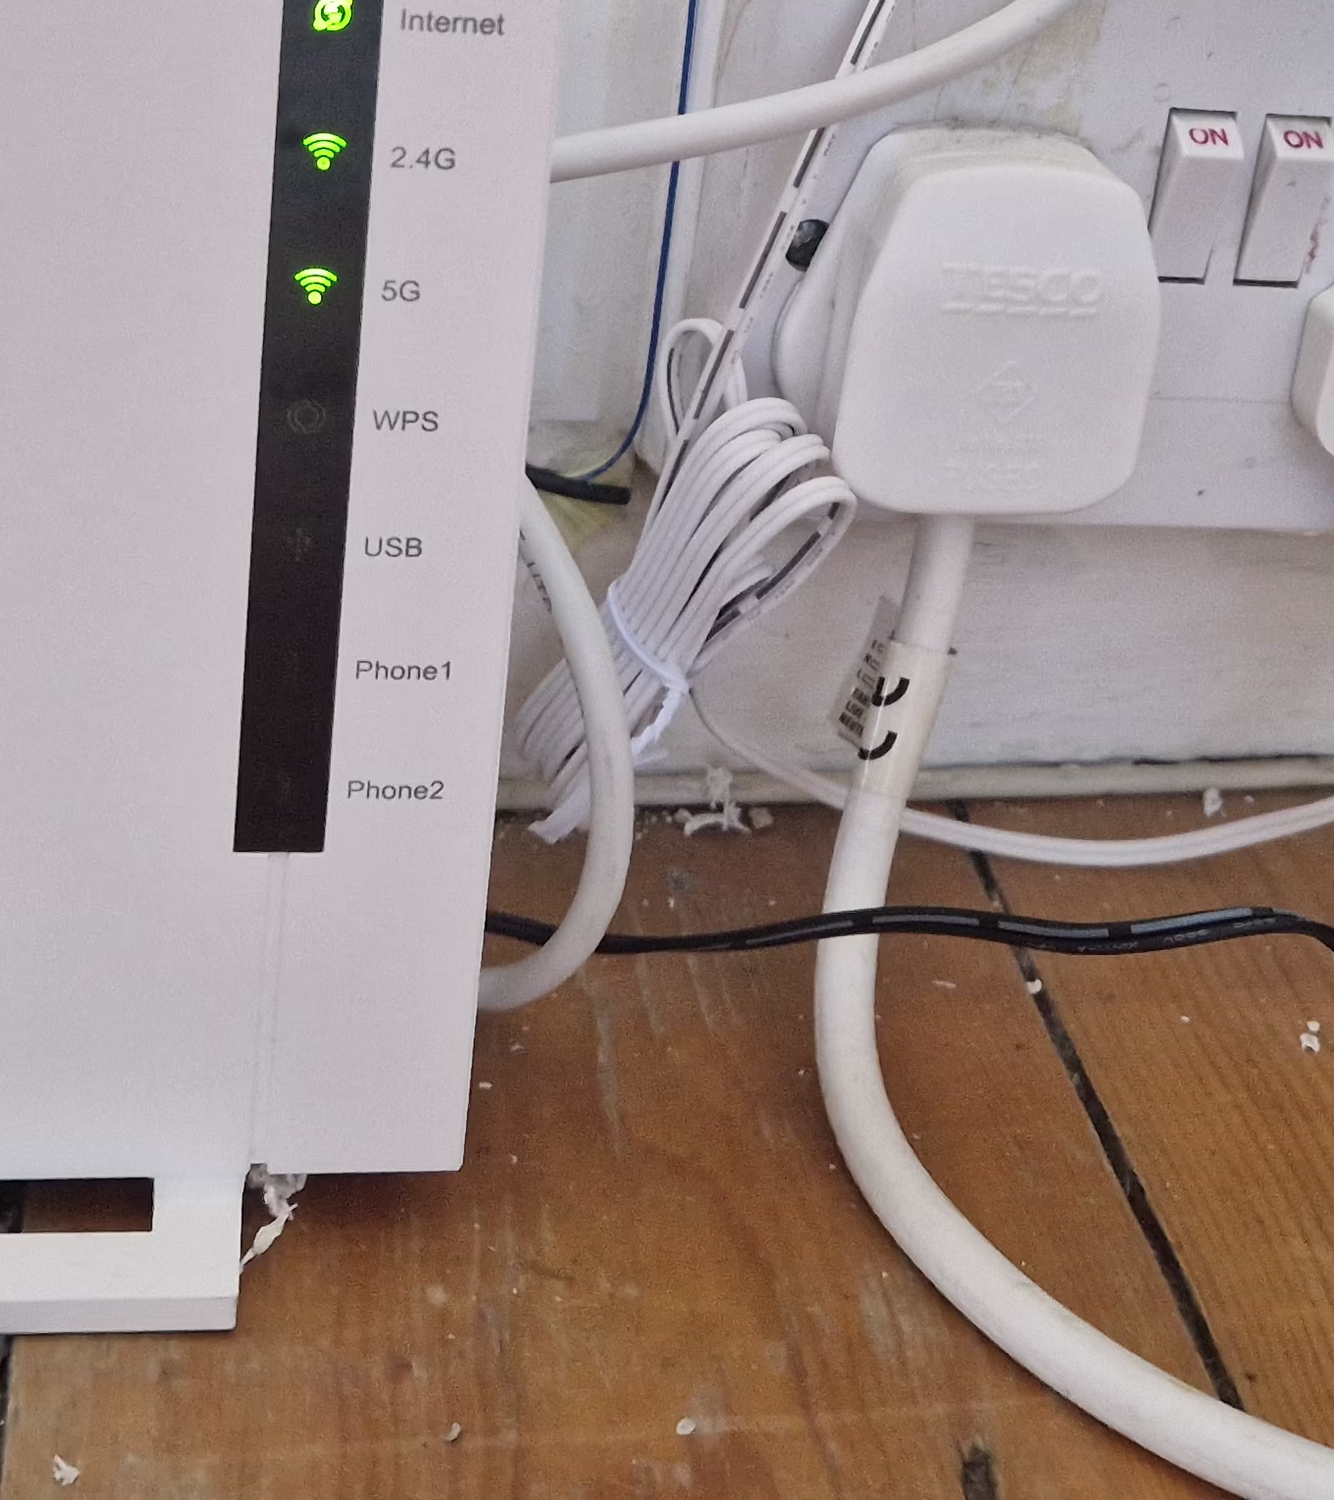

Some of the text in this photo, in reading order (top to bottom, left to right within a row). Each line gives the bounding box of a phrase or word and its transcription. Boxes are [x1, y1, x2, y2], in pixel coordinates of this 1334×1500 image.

[400, 8, 505, 36] Internet
[1188, 127, 1229, 147] ON
[1283, 129, 1324, 149] ON
[389, 146, 457, 171] 2.4G
[380, 280, 422, 302] 5G
[941, 261, 1104, 301] TESCO
[372, 409, 440, 432] WPS
[364, 536, 423, 559] USB
[355, 660, 452, 682] Phone1
[347, 780, 445, 801] Phone2
